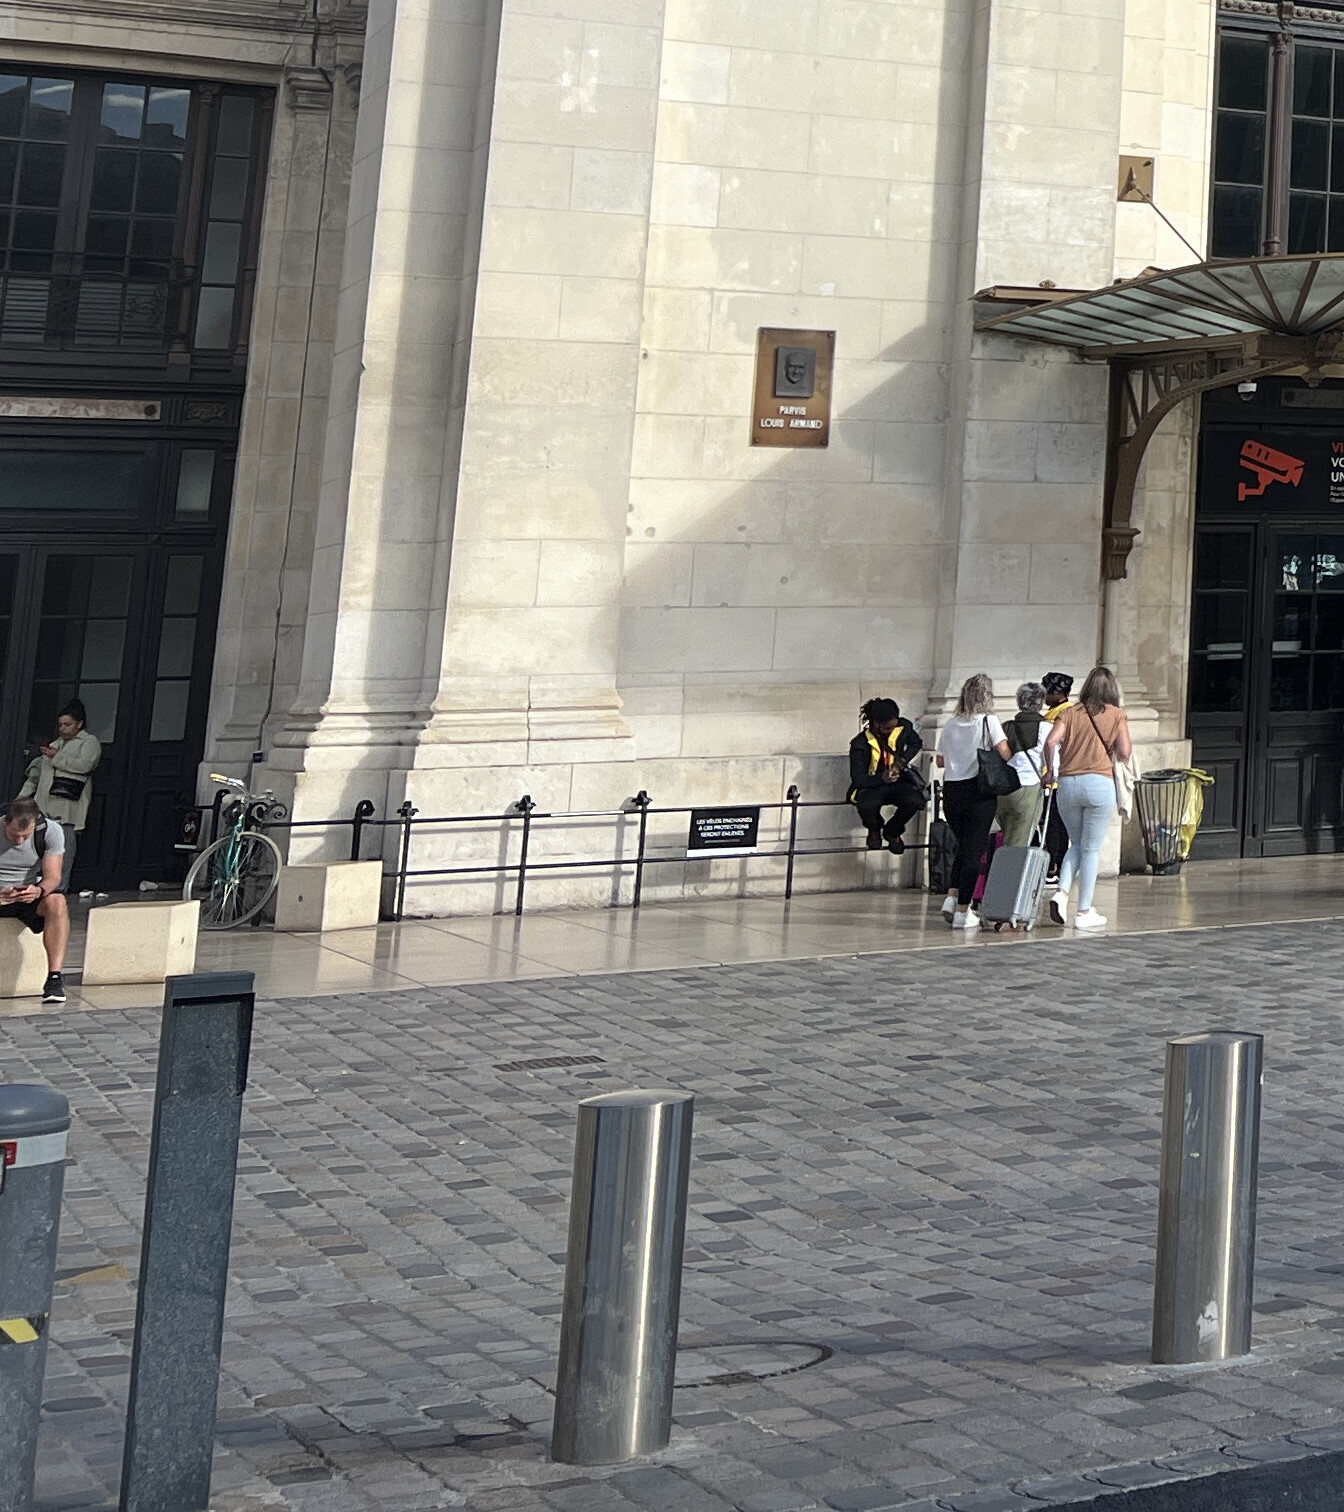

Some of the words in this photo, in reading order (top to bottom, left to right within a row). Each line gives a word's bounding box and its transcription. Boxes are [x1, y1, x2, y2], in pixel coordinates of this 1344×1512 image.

[779, 405, 807, 416] PARVIS
[761, 418, 785, 428] LOUIS
[789, 418, 823, 429] ARMAND
